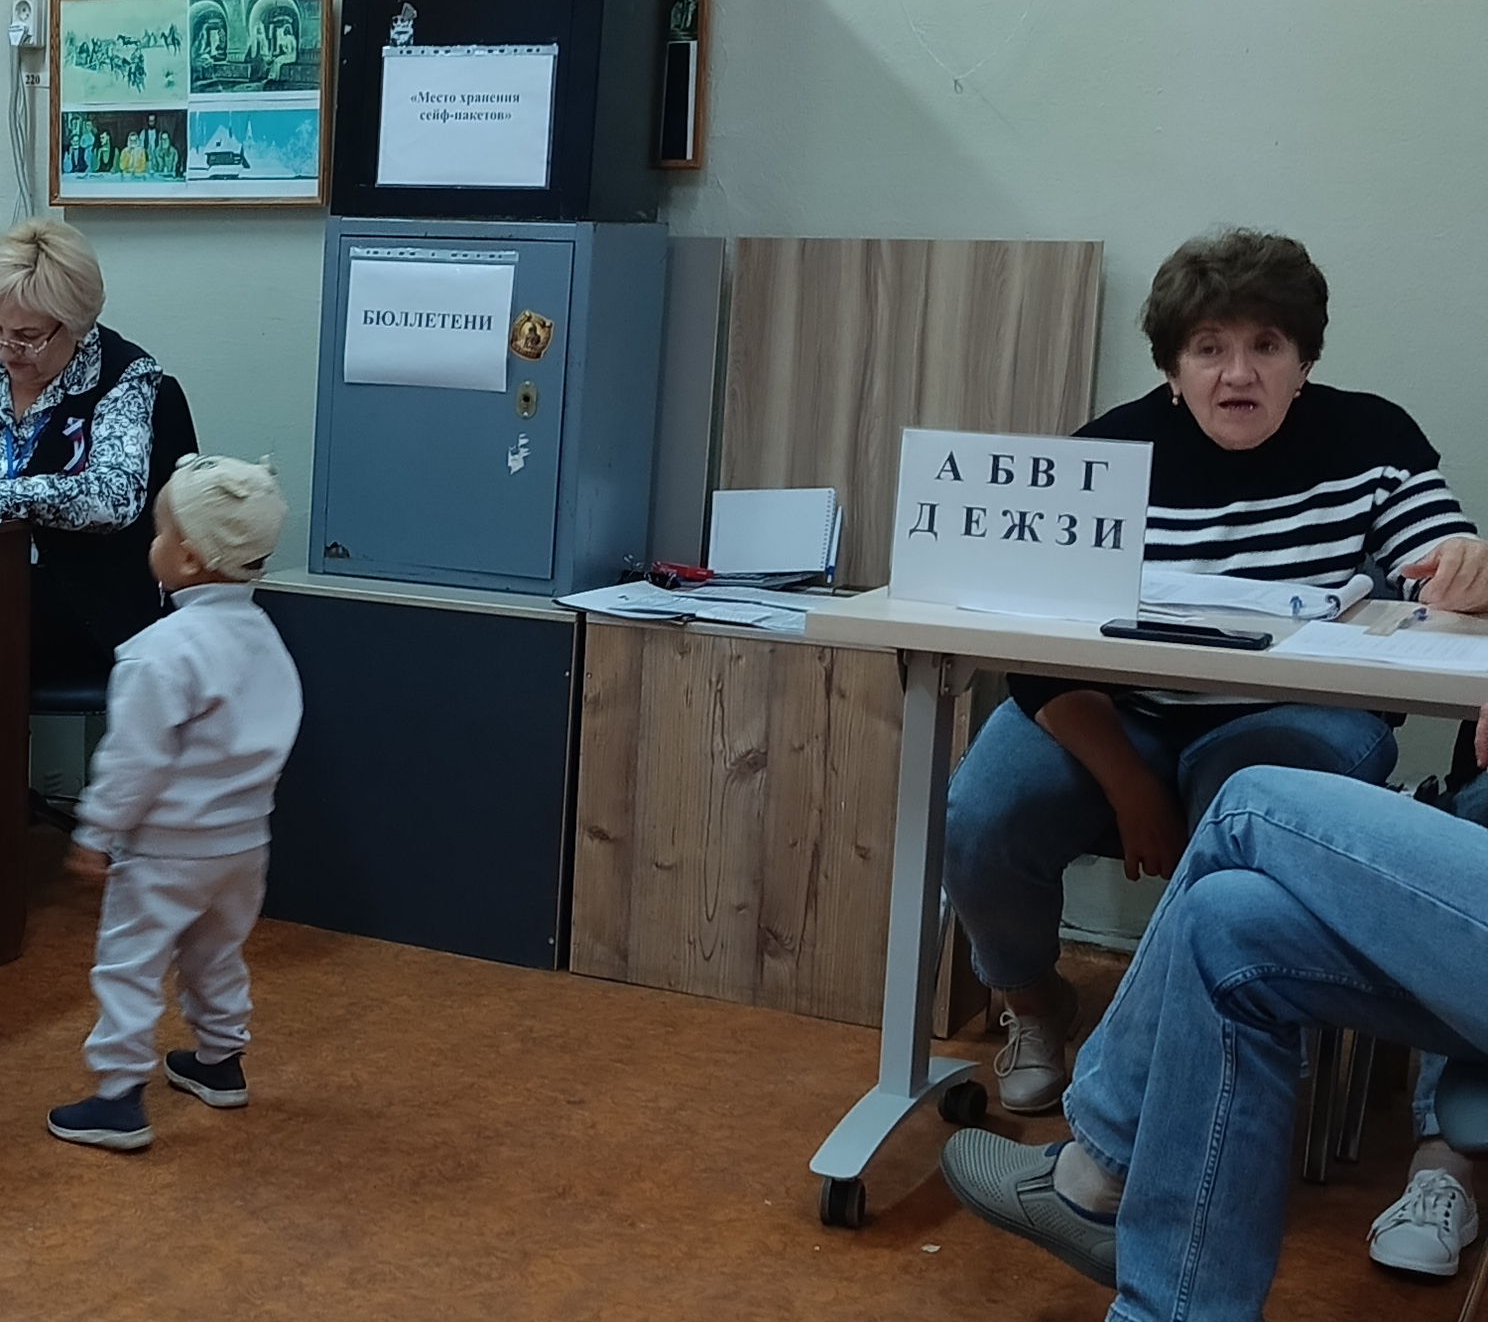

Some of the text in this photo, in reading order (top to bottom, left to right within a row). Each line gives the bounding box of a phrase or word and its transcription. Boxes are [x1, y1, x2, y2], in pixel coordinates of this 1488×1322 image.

[25, 74, 41, 86] 220
[410, 91, 521, 106] «Место хранения
[419, 108, 512, 124] сейф-пакетов»
[362, 309, 493, 332] БЮЛЛЕТЕНИ
